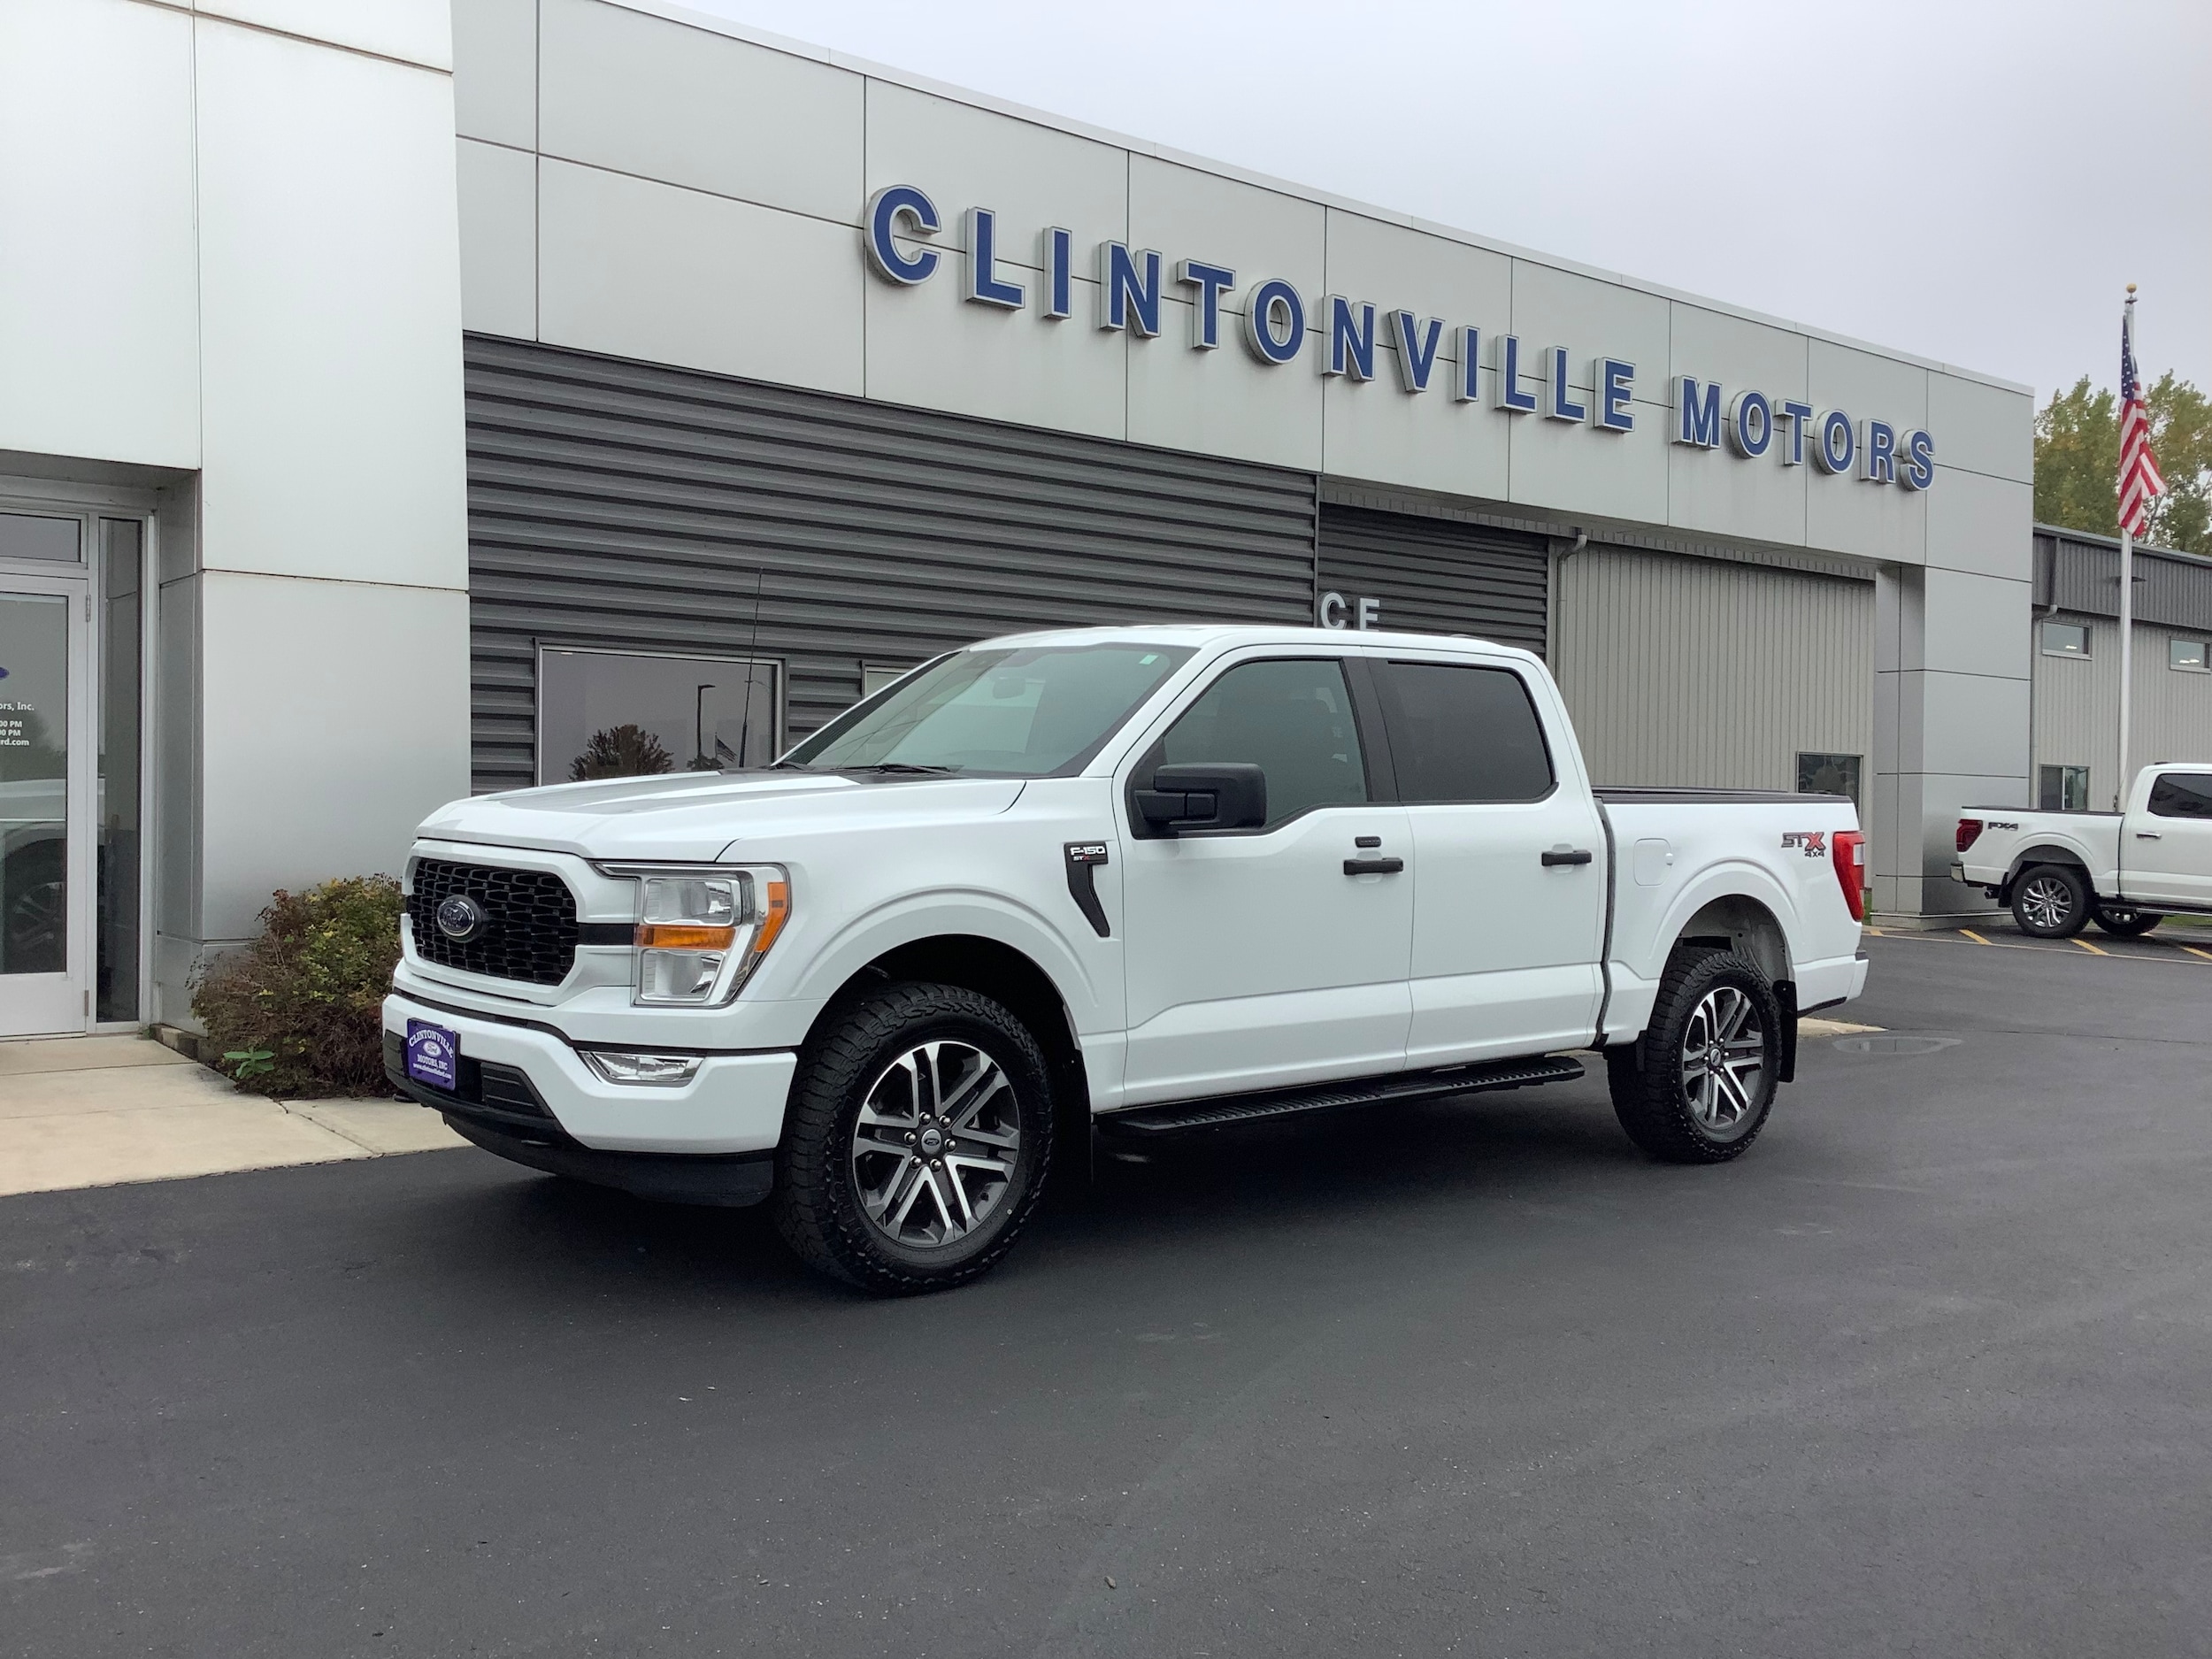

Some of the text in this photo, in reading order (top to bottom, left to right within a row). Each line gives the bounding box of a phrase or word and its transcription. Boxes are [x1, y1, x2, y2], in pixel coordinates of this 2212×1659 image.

[864, 184, 1936, 492] CLINTONVILLE MOTORS
[1320, 592, 1381, 632] CE
[17, 702, 35, 710] Inc.
[1988, 822, 2018, 831] FX4
[1070, 846, 1105, 856] F-150
[1781, 832, 1826, 851] STX
[409, 1029, 454, 1059] CLINTONVILLE
